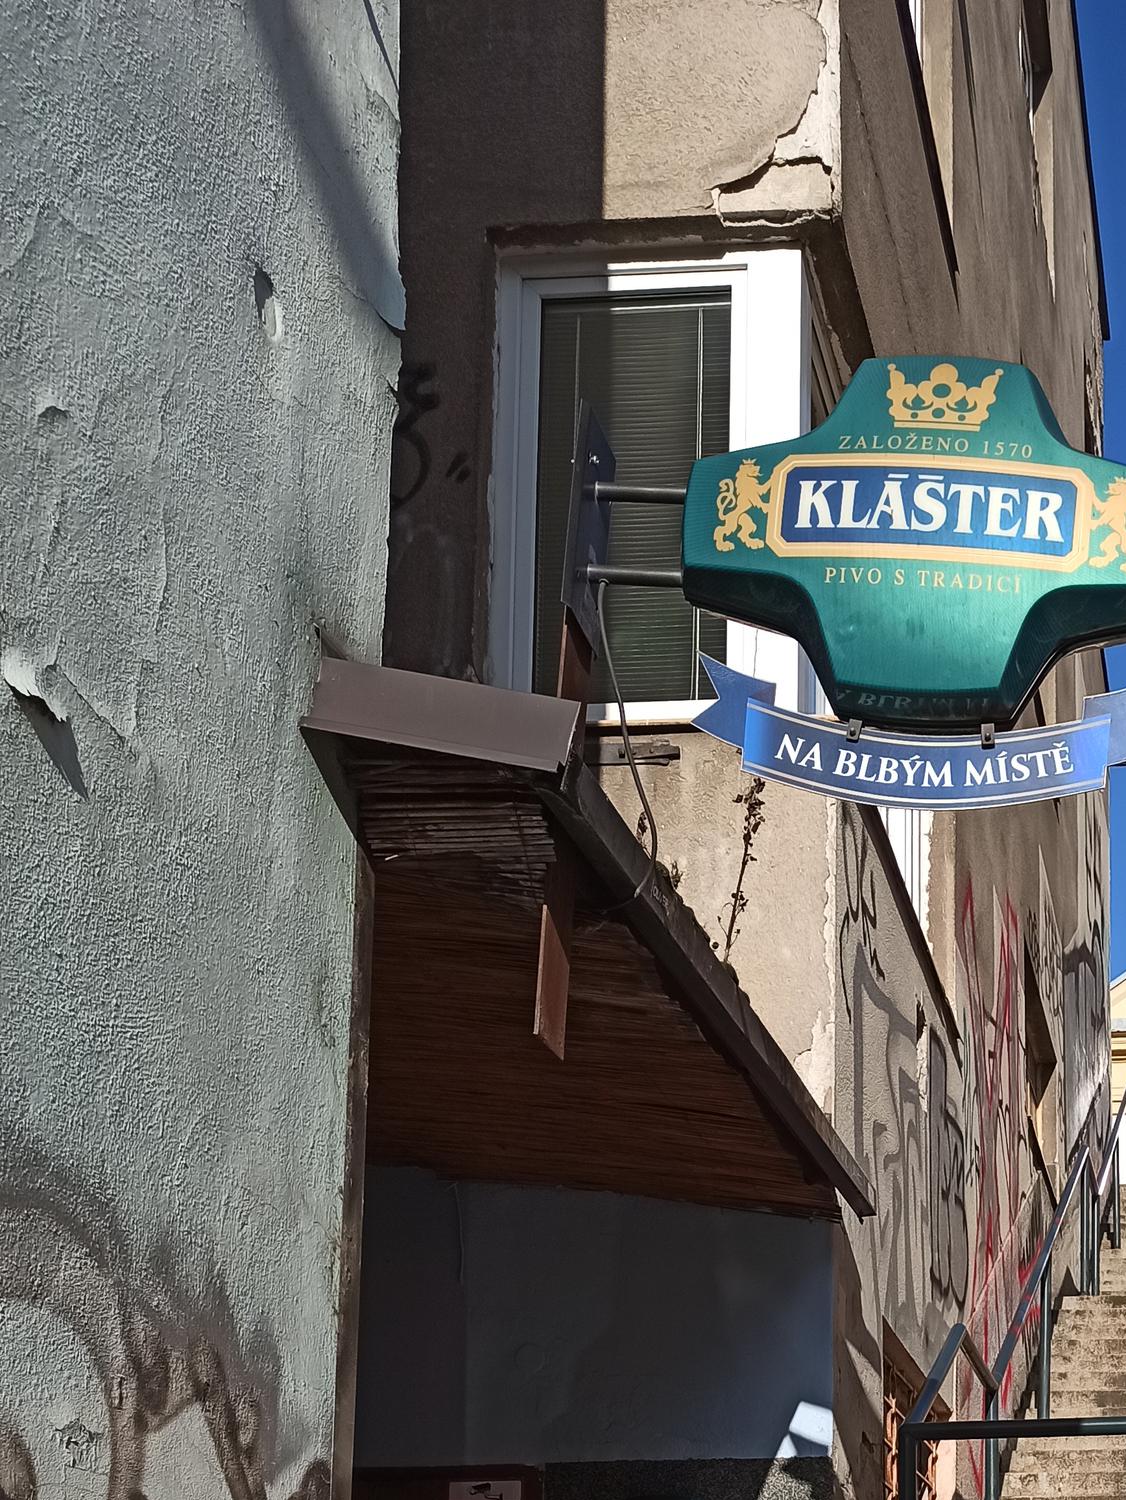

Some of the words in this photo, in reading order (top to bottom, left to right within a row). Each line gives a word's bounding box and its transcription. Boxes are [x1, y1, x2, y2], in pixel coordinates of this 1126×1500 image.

[838, 432, 971, 454] ZALOŽENO
[982, 440, 1034, 460] 1570
[824, 566, 883, 586] PIVO
[893, 569, 906, 586] S
[917, 570, 1023, 595] TRADICÍ
[774, 731, 824, 771] NA
[833, 747, 954, 788] BLBÝM
[964, 741, 1075, 785] MÍSTĚ
